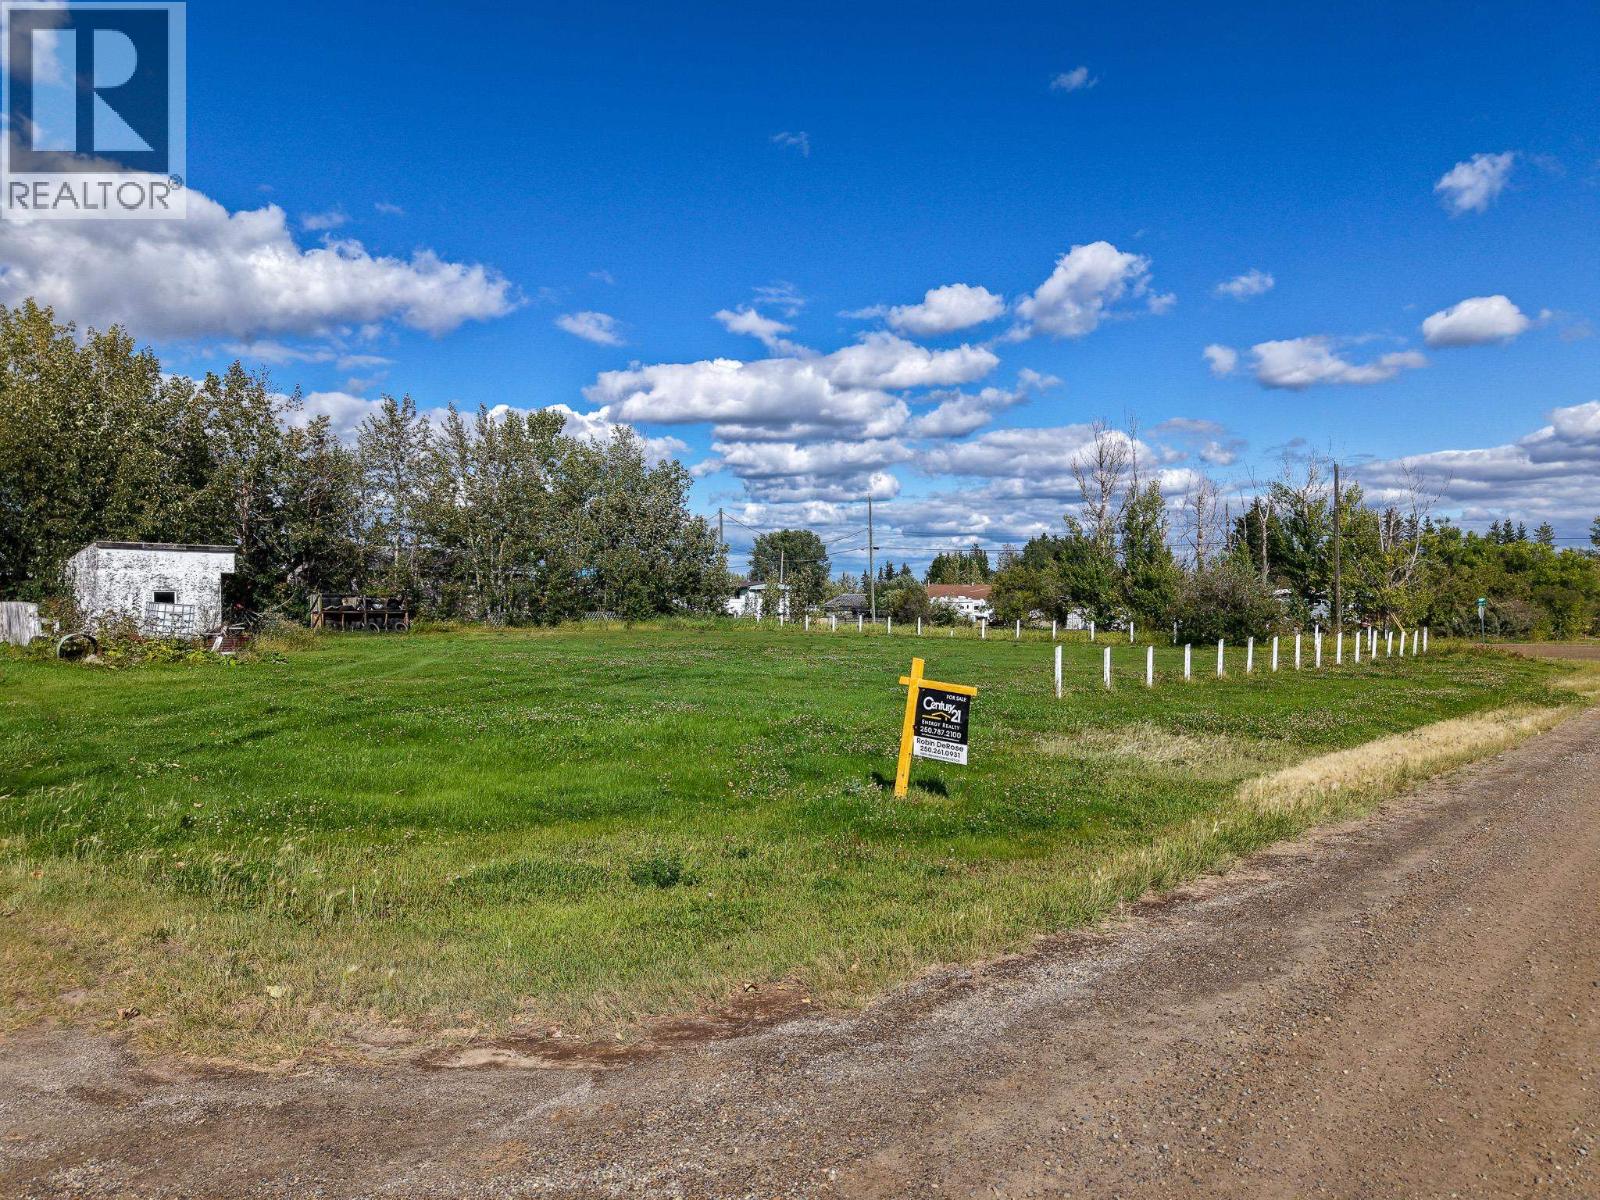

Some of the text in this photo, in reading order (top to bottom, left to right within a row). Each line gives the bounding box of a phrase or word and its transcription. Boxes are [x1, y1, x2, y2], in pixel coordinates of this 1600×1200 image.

[923, 696, 956, 713] Century
[950, 709, 962, 724] 21
[921, 719, 960, 730] ENERGY REALTY
[916, 737, 936, 747] Robin
[936, 741, 964, 752] DeRose
